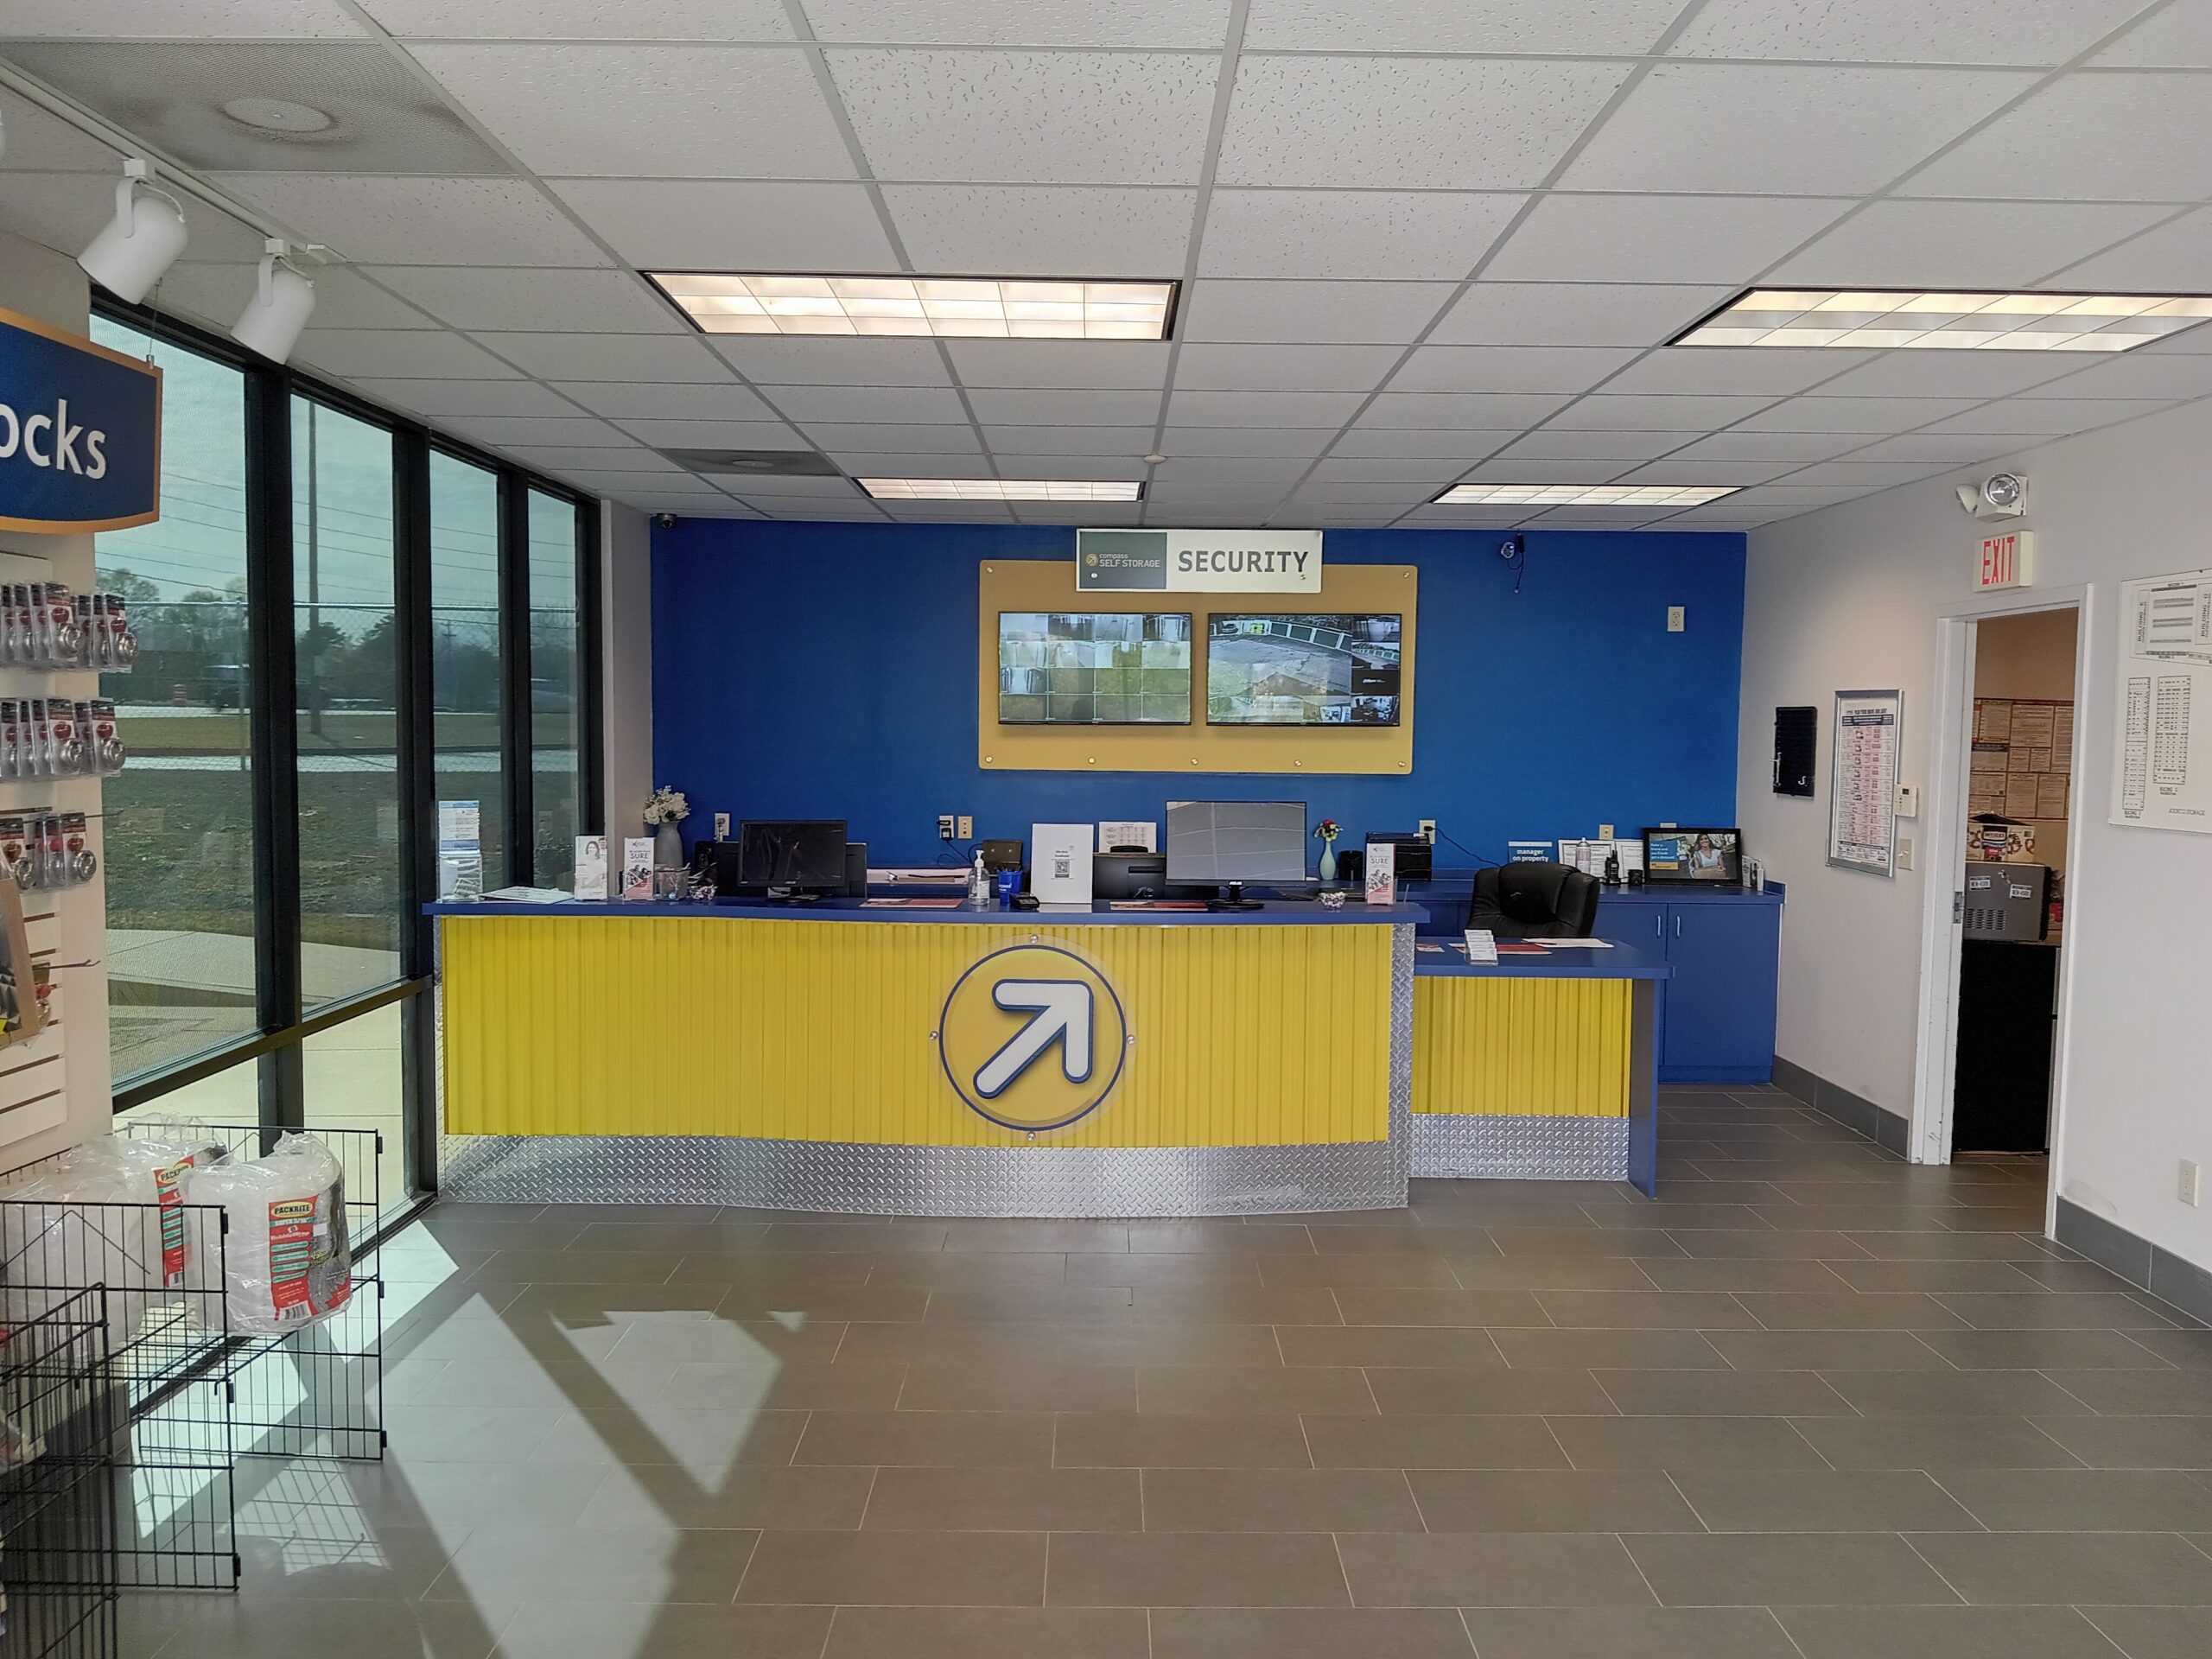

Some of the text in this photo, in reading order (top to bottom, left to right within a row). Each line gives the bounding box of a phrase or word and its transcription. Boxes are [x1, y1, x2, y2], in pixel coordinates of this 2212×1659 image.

[1099, 559, 1160, 568] SELF STORAGE
[1178, 550, 1309, 573] SECURITY
[1982, 536, 2015, 585] EXIT
[274, 1205, 311, 1215] PACKRITE
